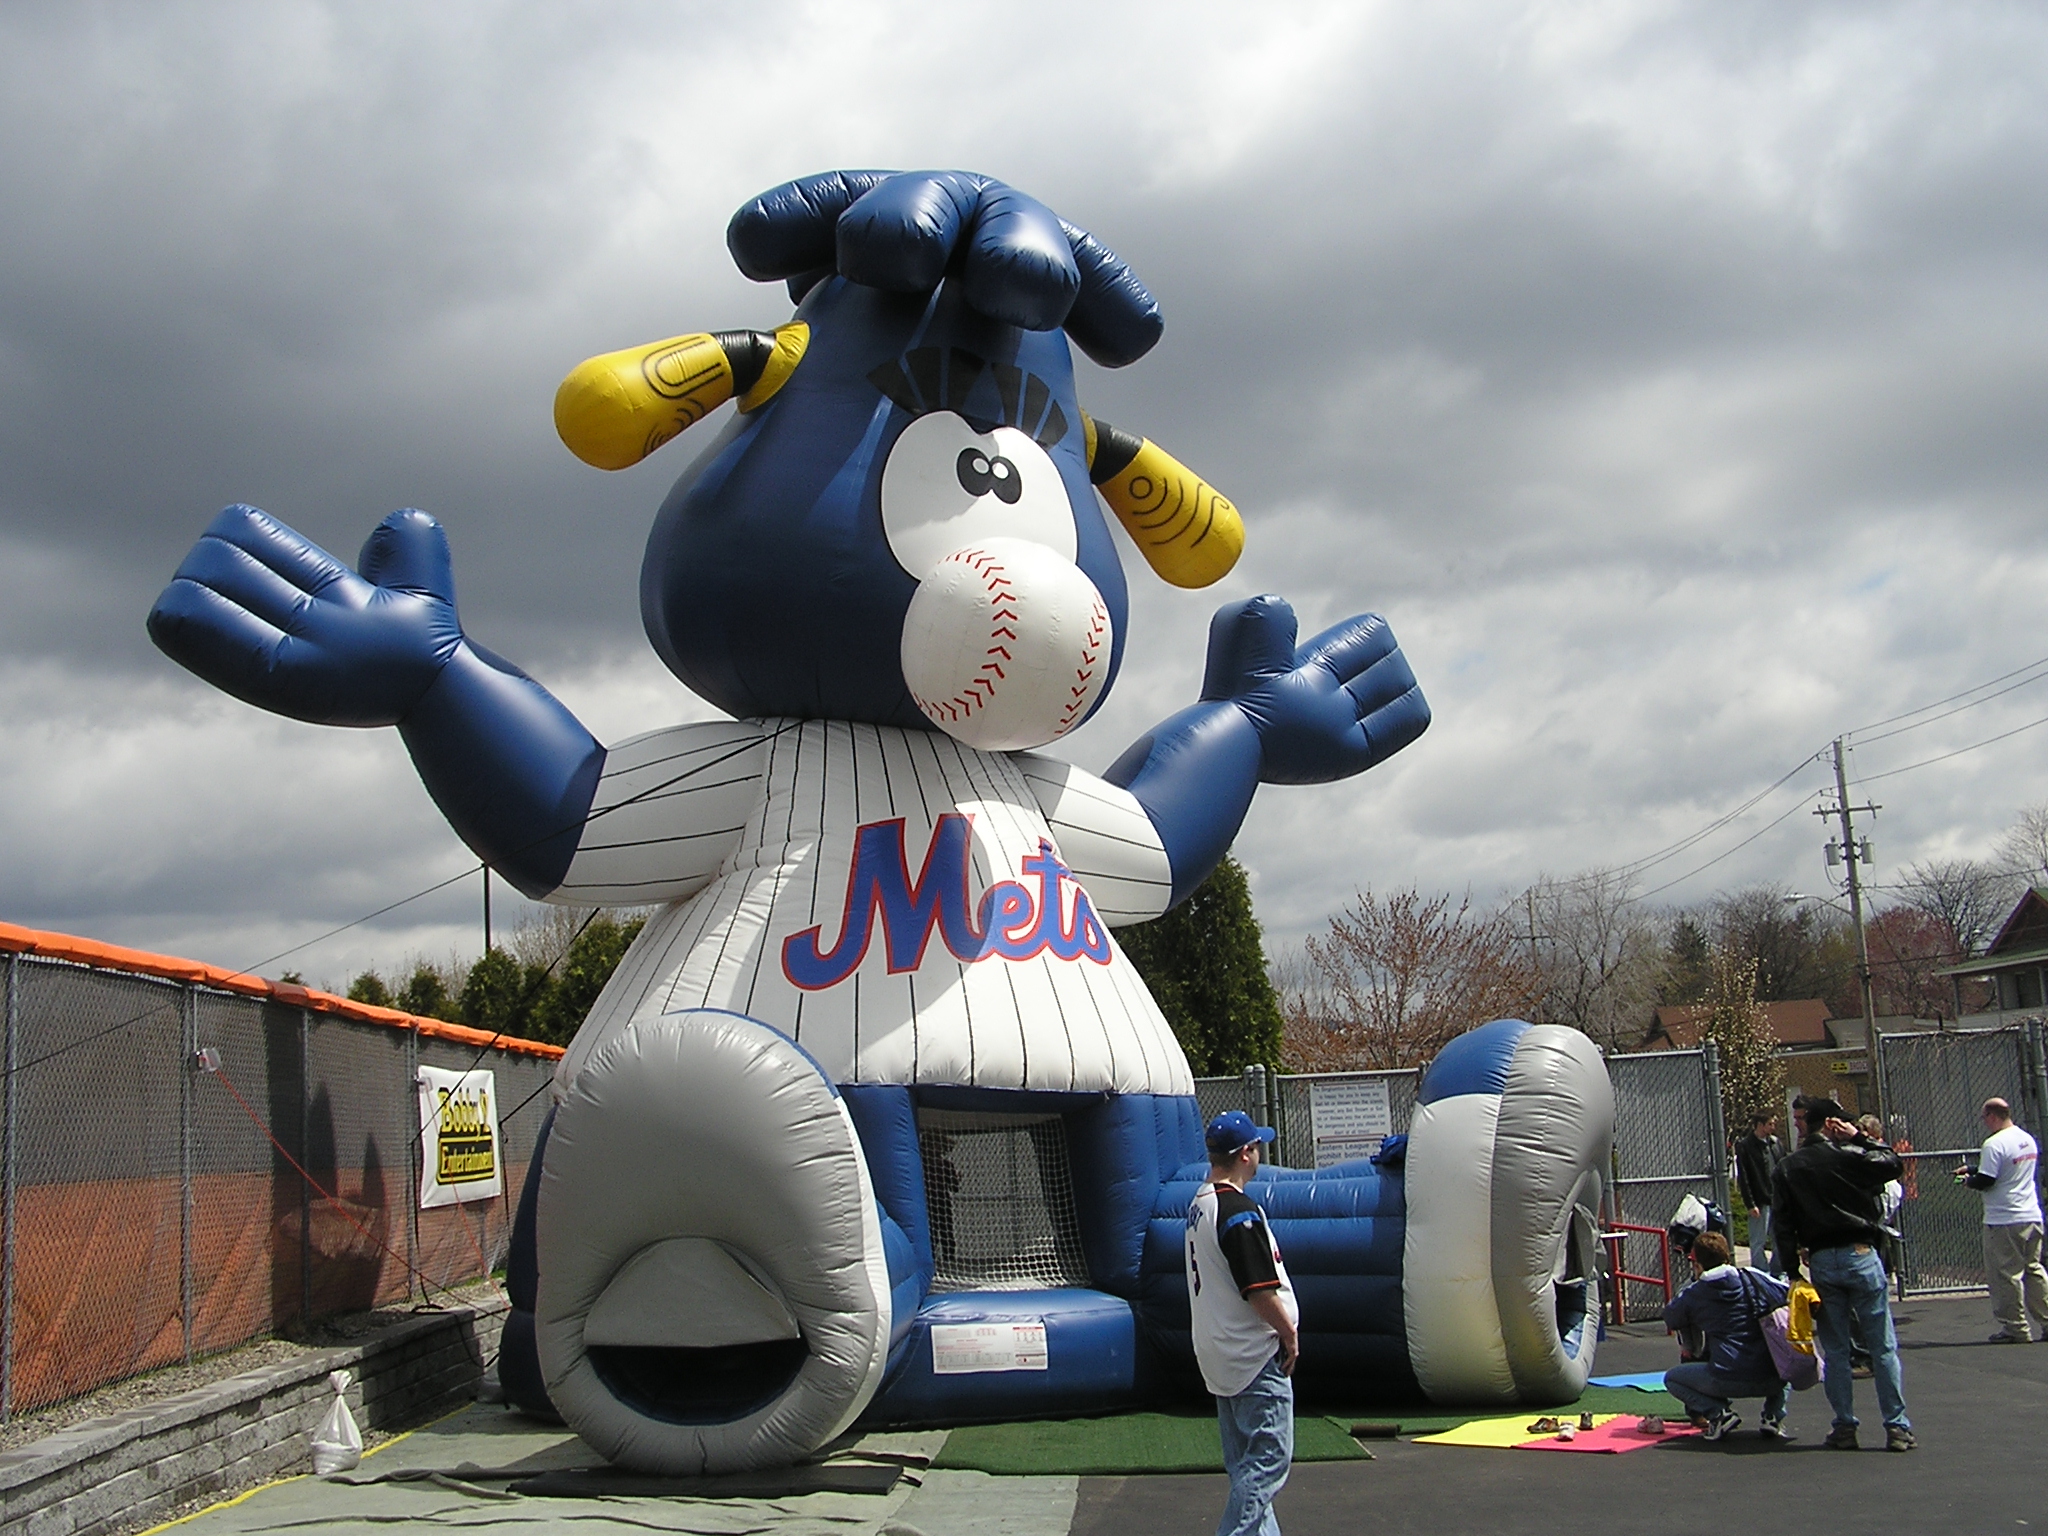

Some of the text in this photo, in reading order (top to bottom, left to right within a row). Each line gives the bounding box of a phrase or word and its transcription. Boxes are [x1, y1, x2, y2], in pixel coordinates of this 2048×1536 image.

[781, 813, 1112, 991] Mets
[1316, 1143, 1343, 1151] Eastern
[1345, 1142, 1370, 1151] League
[1316, 1152, 1342, 1161] prohibit
